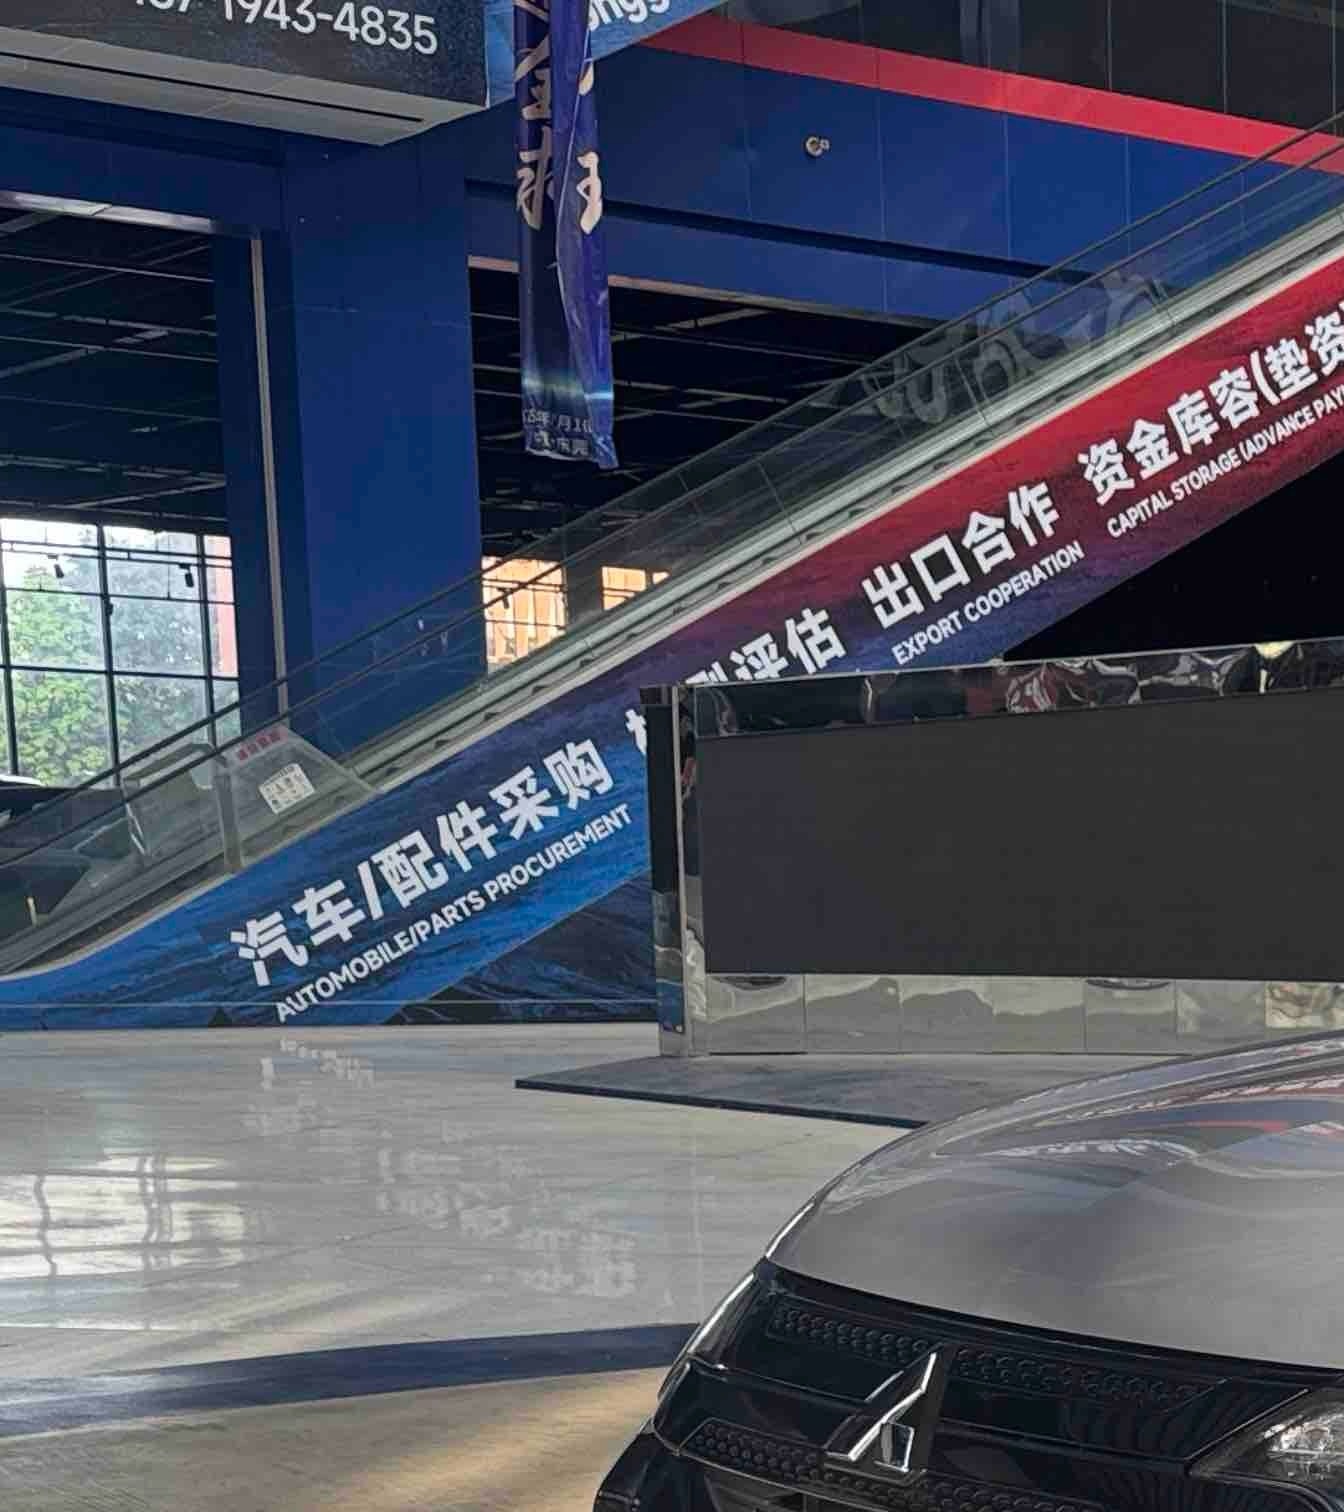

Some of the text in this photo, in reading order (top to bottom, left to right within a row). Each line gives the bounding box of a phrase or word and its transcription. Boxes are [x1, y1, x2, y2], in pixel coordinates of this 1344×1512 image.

[1106, 489, 1173, 539] CAPITAL
[1171, 448, 1241, 502] STORAGE
[1240, 405, 1316, 463] (ADVANCE
[862, 481, 1060, 629] 出口合作
[891, 540, 1086, 666] EXPORT COOPERATION
[230, 738, 614, 987] 汽车/配件采购
[275, 802, 633, 1023] AUTOMOBILE/PARTS PROCUREMENT
